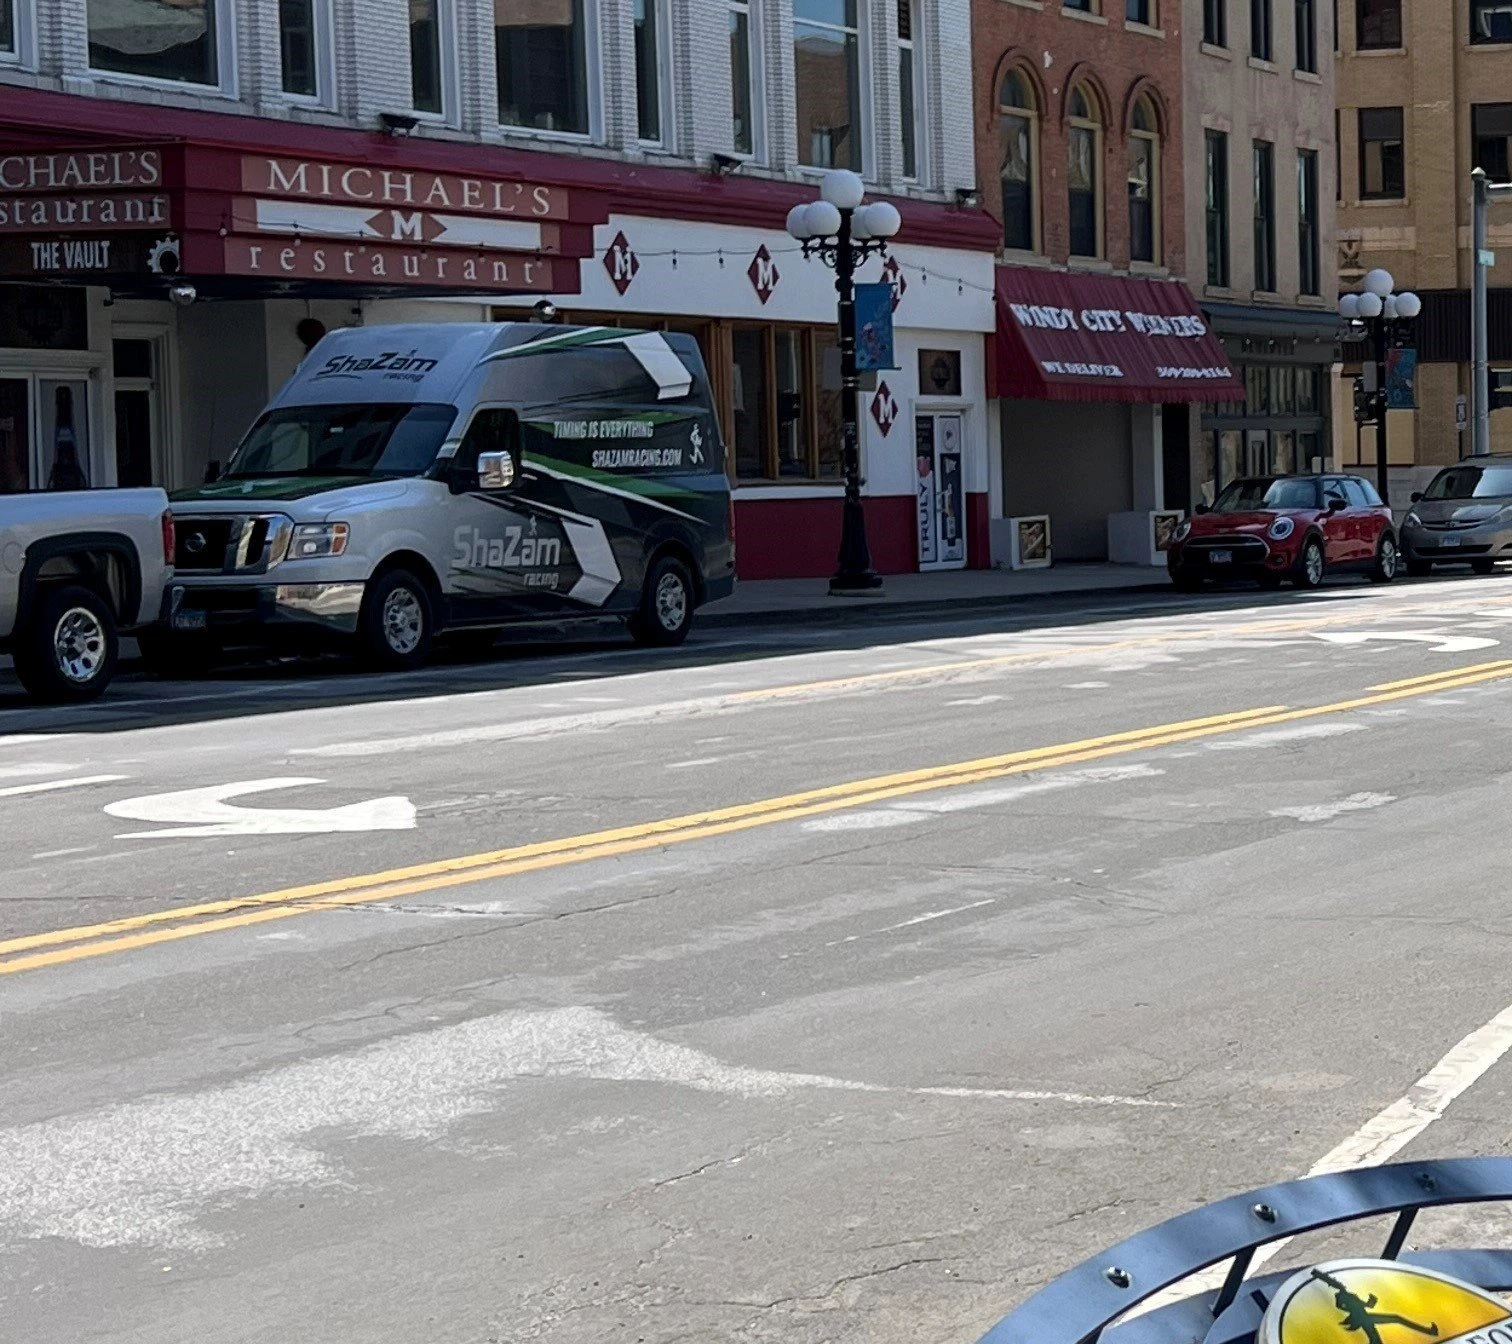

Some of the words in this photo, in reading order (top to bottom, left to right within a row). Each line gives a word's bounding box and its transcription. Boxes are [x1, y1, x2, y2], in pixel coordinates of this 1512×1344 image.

[0, 151, 158, 188] CHAEL'S
[266, 160, 552, 216] MICHAEL'S
[0, 196, 166, 225] staurant
[391, 210, 423, 240] M
[31, 241, 60, 270] THE
[64, 241, 110, 269] VAULT
[250, 245, 534, 284] restaurant
[1010, 304, 1079, 330] WINDY
[316, 351, 438, 375] ShaZam
[554, 421, 587, 439] TIMING
[600, 421, 654, 439] EVERYTHING
[451, 524, 561, 568] ShaZam
[523, 572, 560, 589] racing
